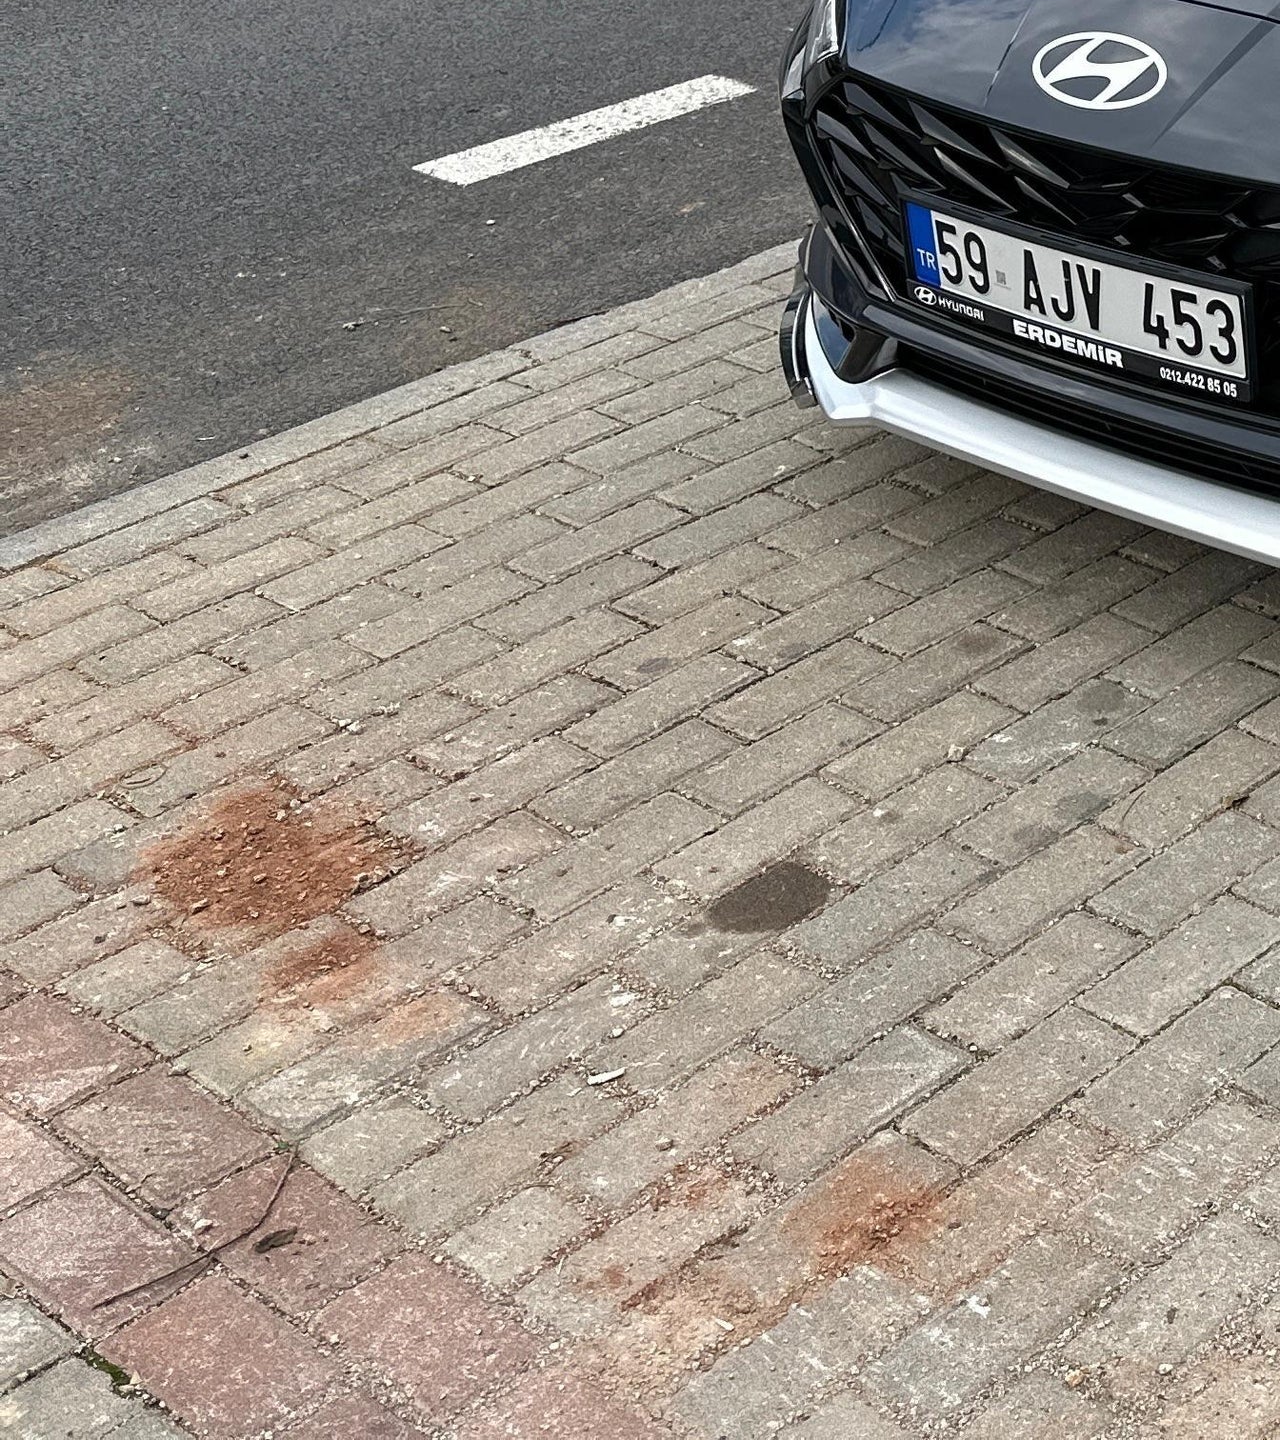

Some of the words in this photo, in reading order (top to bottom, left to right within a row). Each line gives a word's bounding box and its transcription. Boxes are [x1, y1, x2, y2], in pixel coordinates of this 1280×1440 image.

[917, 248, 937, 271] TR
[935, 219, 990, 295] 59
[1023, 249, 1101, 331] AJV
[1143, 282, 1237, 365] 453
[938, 295, 985, 321] HYUNDAI
[1207, 377, 1221, 394] 85
[1223, 381, 1238, 398] 05
